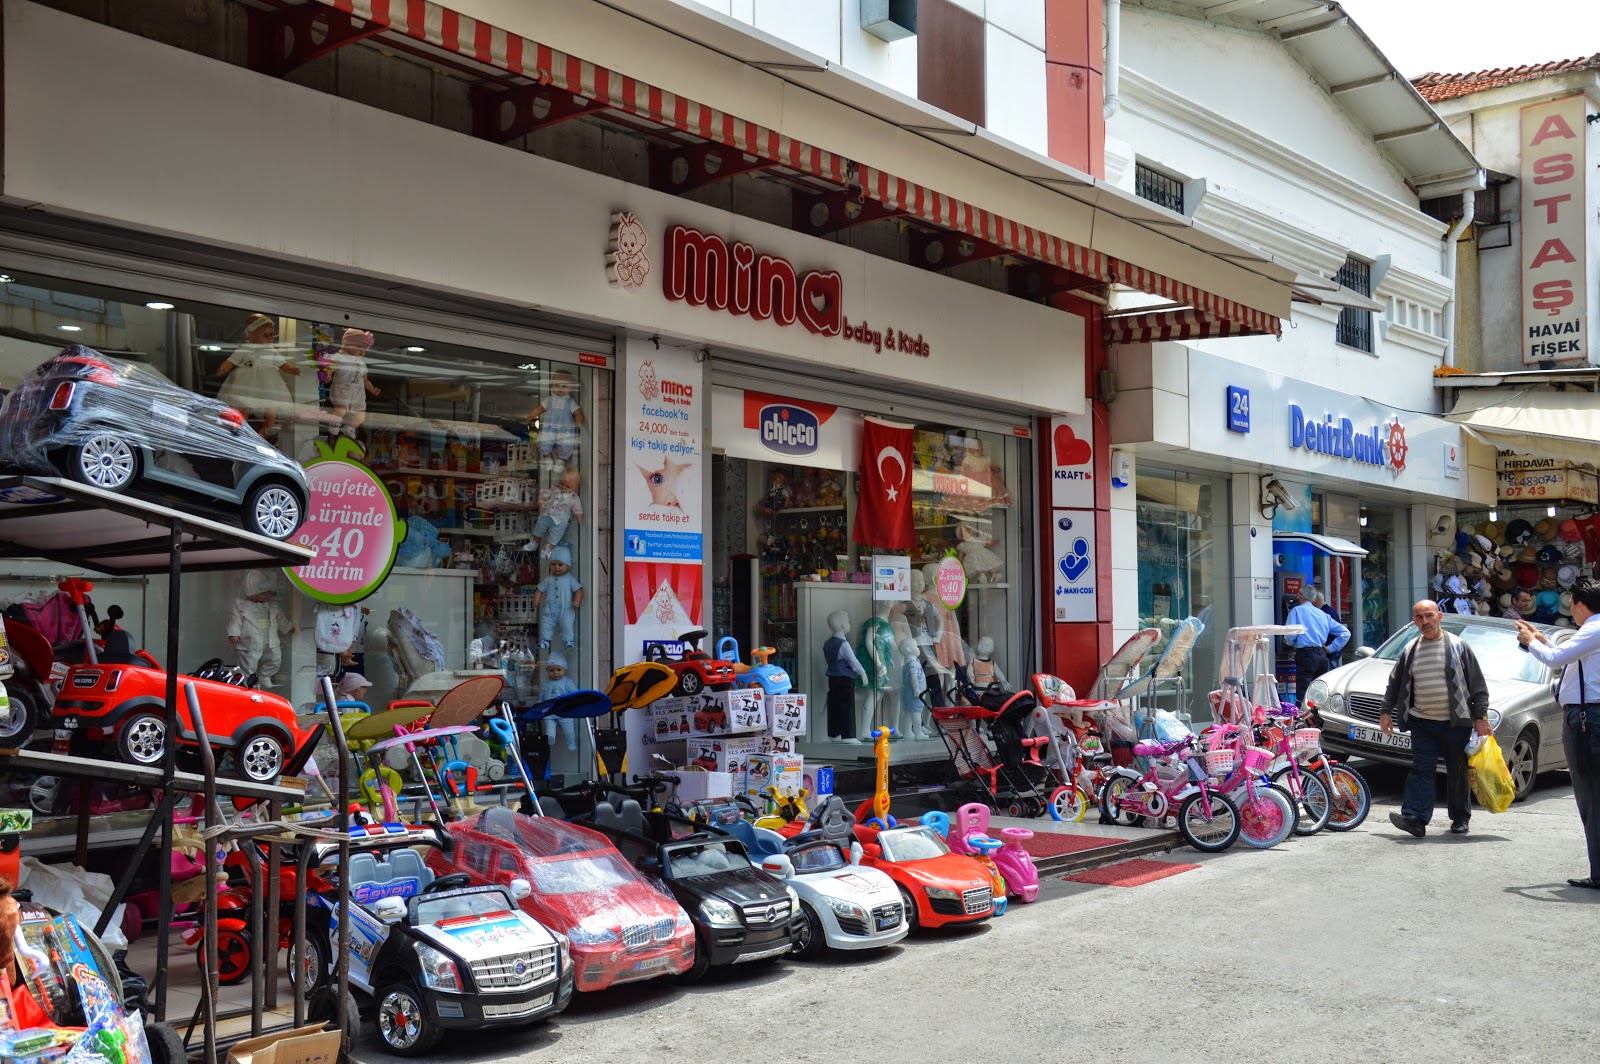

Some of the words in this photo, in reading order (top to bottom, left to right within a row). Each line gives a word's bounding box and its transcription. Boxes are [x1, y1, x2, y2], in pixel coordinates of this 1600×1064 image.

[1529, 113, 1577, 317] ASTAŞ
[663, 224, 843, 337] mina
[843, 316, 882, 354] baby
[884, 327, 896, 351] &
[1529, 318, 1580, 338] HAVAİ
[1531, 339, 1581, 357] FİŞEK
[661, 380, 693, 398] mina
[642, 404, 689, 421] facebook'ta
[1232, 392, 1249, 416] 24
[639, 421, 668, 435] 24,000
[763, 408, 816, 447] chicco
[1288, 403, 1386, 467] DenizBank
[631, 437, 645, 451] kişi
[647, 440, 668, 454] takip
[1504, 459, 1554, 469] HIRDAVAT
[1054, 470, 1084, 480] KRAFT
[1506, 487, 1523, 497] 07
[1528, 486, 1547, 496] 43
[638, 512, 660, 521] sende
[662, 512, 680, 525] takip
[681, 514, 690, 523] et
[942, 581, 958, 594] %40
[1355, 728, 1367, 740] 35
[1371, 731, 1383, 743] AN
[1386, 734, 1411, 748] 7059
[355, 884, 414, 904] Seven
